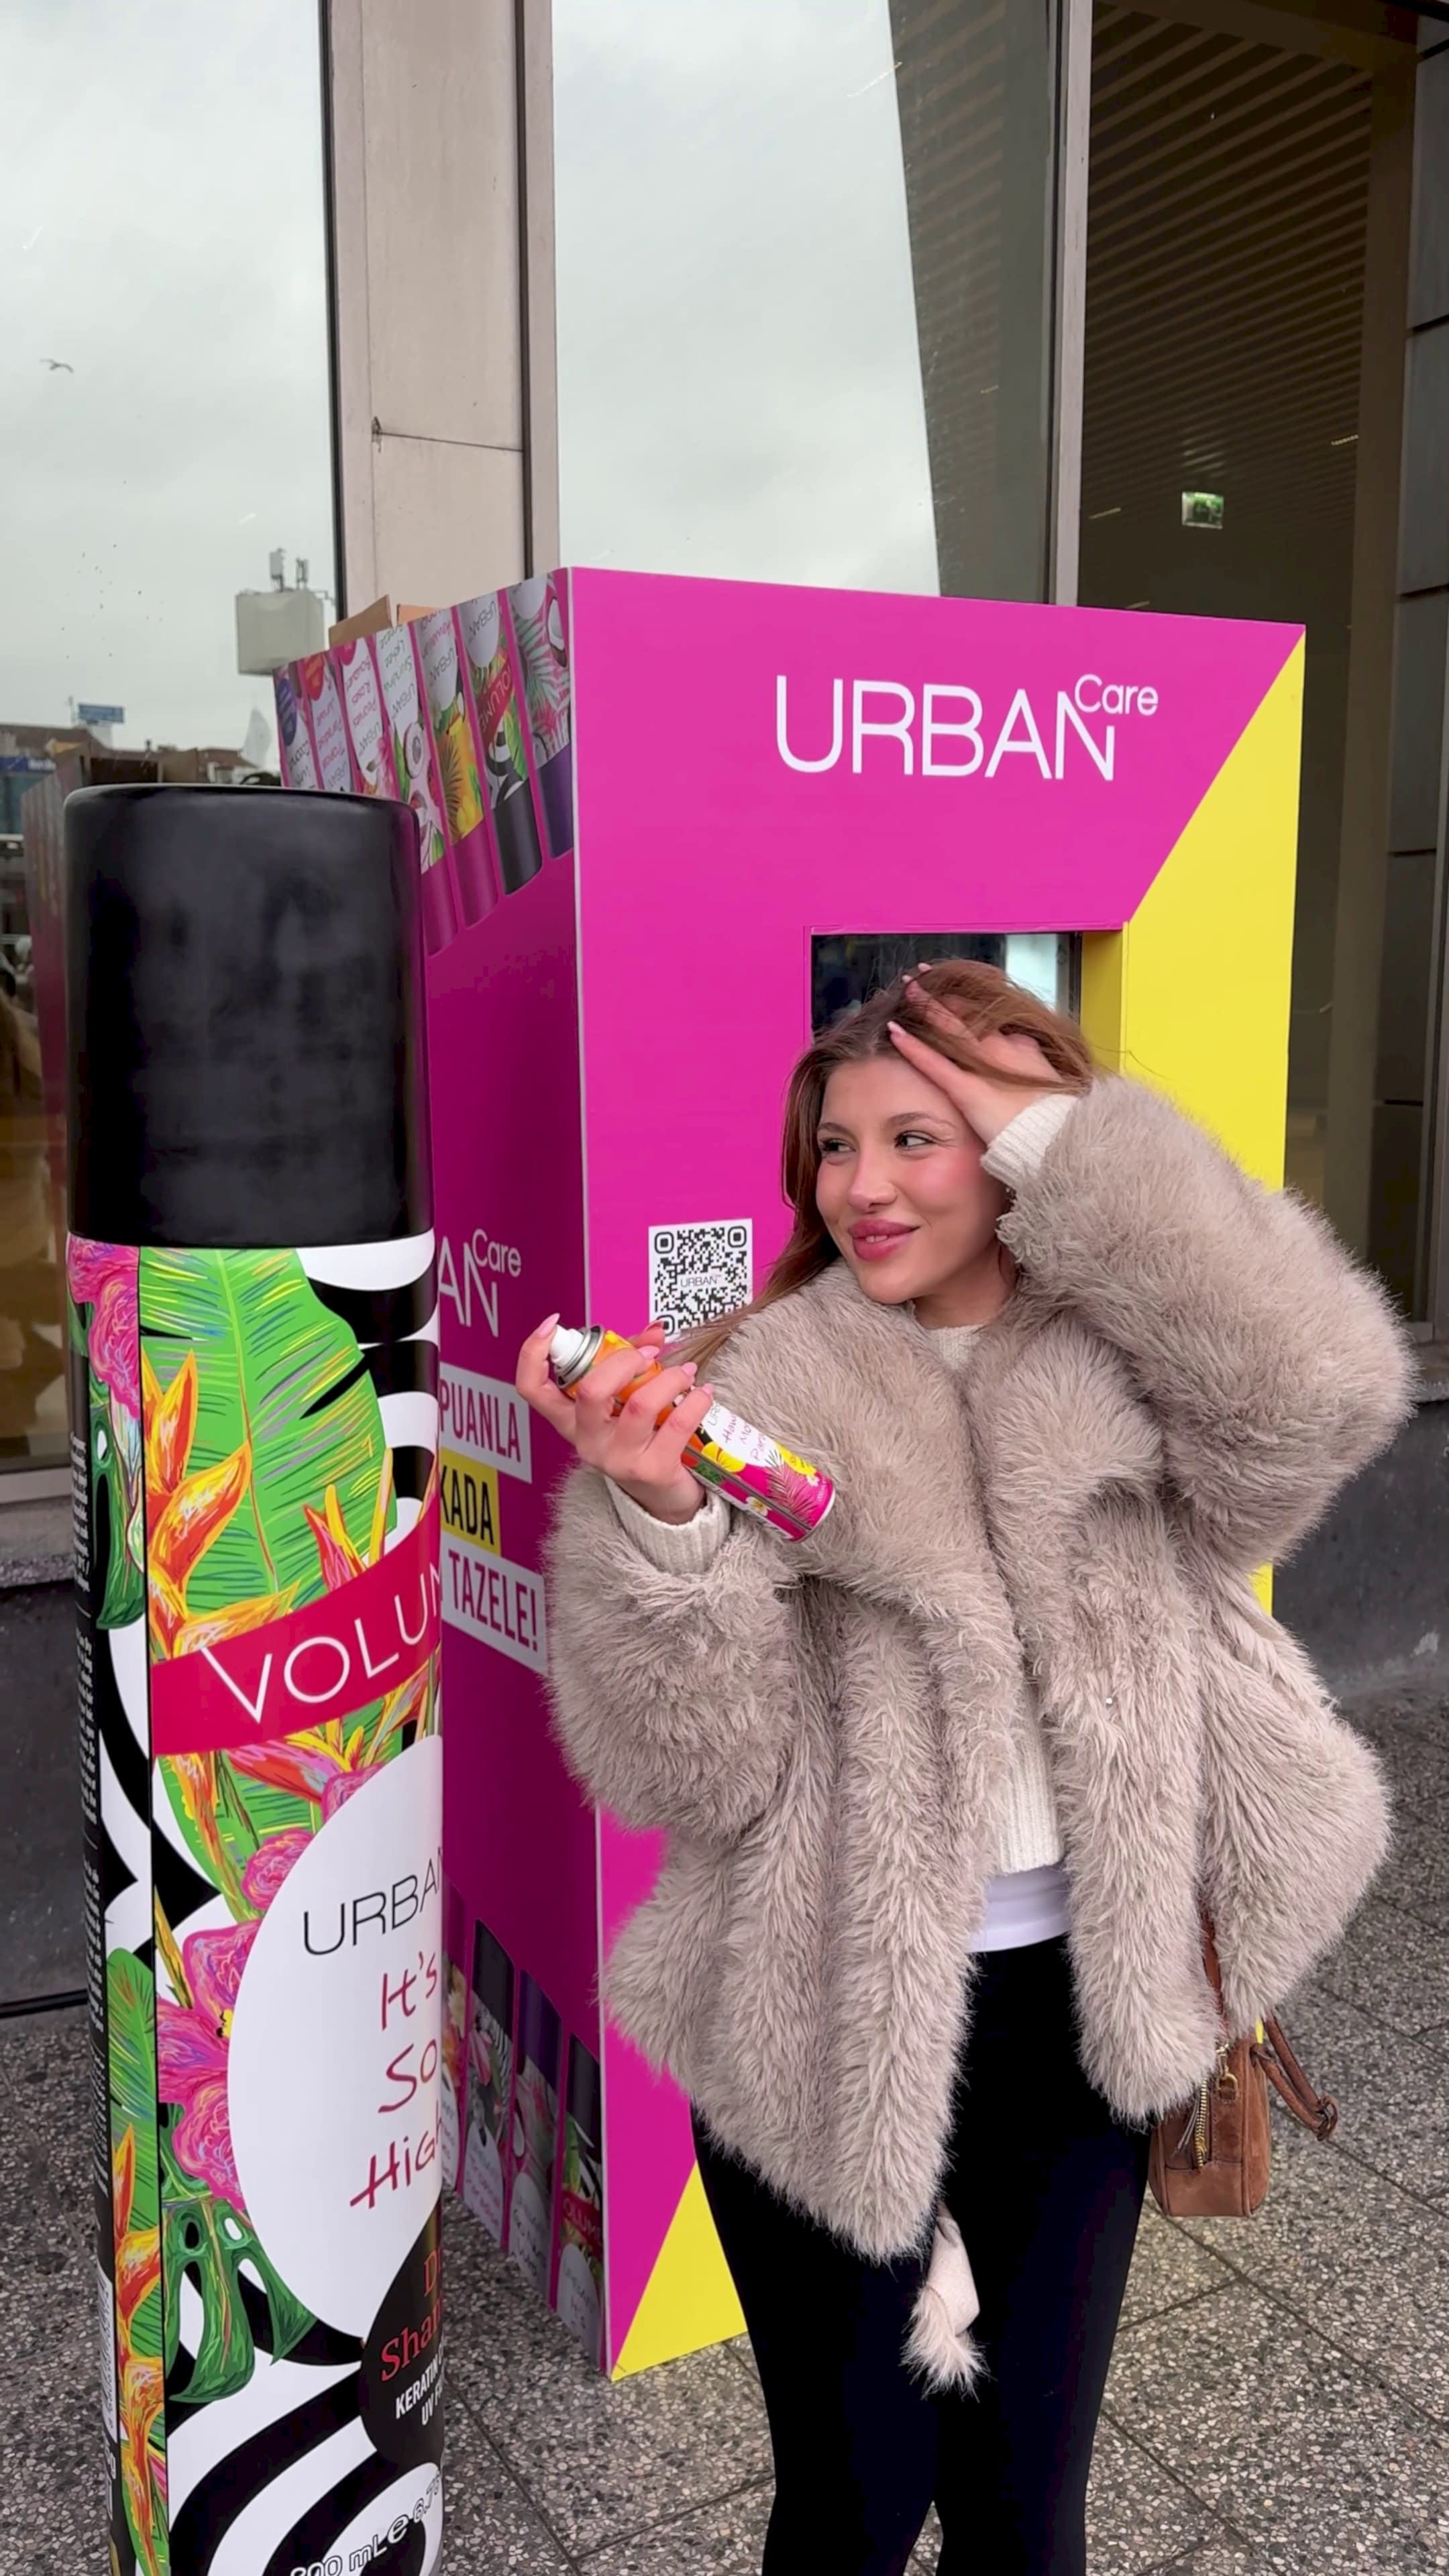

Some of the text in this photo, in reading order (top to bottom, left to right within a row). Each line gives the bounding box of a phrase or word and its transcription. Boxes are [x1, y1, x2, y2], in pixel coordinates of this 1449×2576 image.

[777, 674, 1159, 782] URBAN Care
[472, 1228, 522, 1278] Care
[680, 1276, 718, 1288] URBAN
[439, 1379, 521, 1463] PUANLA
[448, 1548, 538, 1652] TAZELE!
[381, 1951, 438, 2031] It's
[395, 2353, 438, 2420] KERATIN
[421, 2392, 435, 2426] UV
